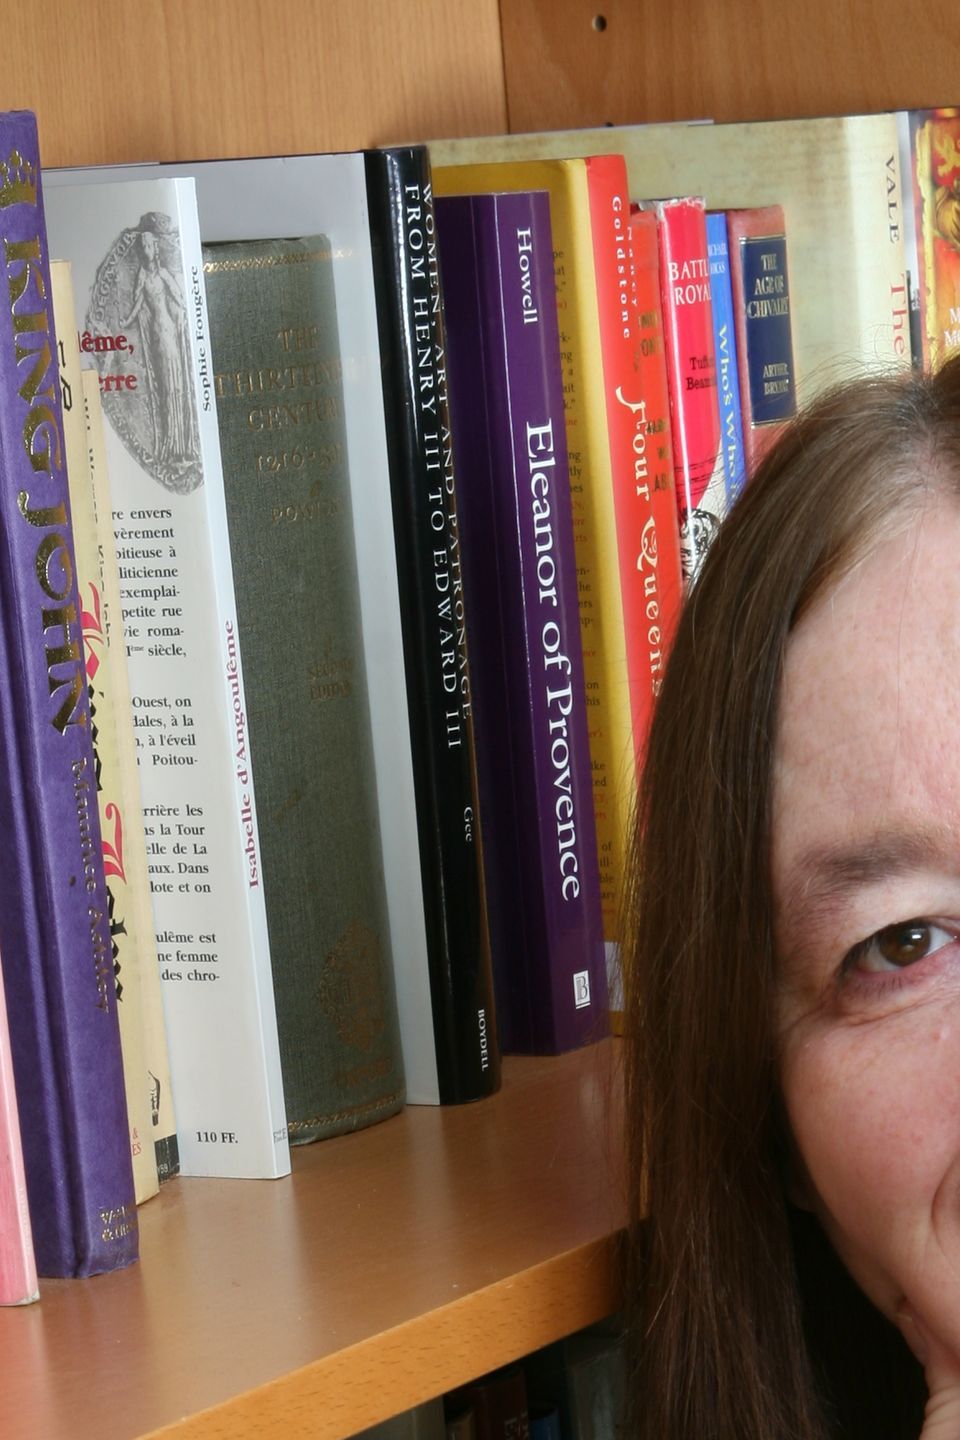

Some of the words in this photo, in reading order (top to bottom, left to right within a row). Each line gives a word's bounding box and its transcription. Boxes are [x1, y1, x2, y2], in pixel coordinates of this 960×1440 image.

[885, 155, 900, 244] VALE
[404, 184, 426, 280] FROM
[517, 227, 538, 324] Howell
[612, 196, 631, 339] Goldstone
[760, 253, 777, 271] THE
[191, 265, 204, 341] Fougère
[673, 284, 712, 306] ROYA
[754, 276, 774, 296] AGE
[775, 275, 785, 293] OF
[890, 273, 907, 355] The
[4, 235, 62, 479] KING
[413, 298, 438, 414] HENRY
[718, 324, 734, 406] Who's
[198, 347, 211, 412] Sophie
[435, 344, 448, 406] ART
[424, 431, 440, 471] III
[441, 425, 455, 494] AND
[615, 386, 649, 502] Four
[130, 508, 173, 520] envers
[428, 487, 445, 531] TO
[525, 417, 558, 608] Eleanor
[113, 527, 175, 540] vèrement
[169, 545, 177, 558] à
[119, 566, 178, 579] liticienne
[120, 585, 181, 601] exemplai-
[17, 489, 87, 737] JOHN
[122, 605, 156, 621] petite
[162, 607, 183, 617] rue
[147, 626, 185, 637] roma-
[433, 549, 457, 694] EDWARD
[448, 513, 471, 720] PATRONAGE
[148, 643, 187, 658] siècle,
[541, 621, 572, 676] of
[132, 696, 172, 710] Ouest,
[175, 697, 192, 708] on
[171, 714, 178, 727] à
[182, 714, 194, 727] la
[225, 619, 248, 786] d'Angoulême
[148, 734, 156, 747] à
[160, 733, 196, 747] l'éveil
[446, 710, 461, 749] III
[152, 754, 198, 766] Poitou-
[143, 804, 180, 817] rrière
[186, 803, 203, 817] les
[546, 681, 581, 902] Provence
[160, 824, 171, 836] la
[175, 823, 205, 836] Tour
[241, 793, 259, 889] Isabelle
[464, 806, 473, 842] Gee
[172, 842, 187, 855] de
[193, 843, 207, 855] La
[148, 864, 174, 874] aux.
[178, 861, 209, 874] Dans
[150, 880, 174, 893] lote
[178, 882, 190, 893] et
[194, 883, 211, 893] on
[156, 930, 193, 943] ulême
[199, 932, 216, 943] est
[157, 952, 172, 963] ne
[176, 950, 219, 963] femme
[161, 968, 182, 981] des
[187, 968, 220, 981] chro-
[478, 1008, 488, 1071] BOYDELL
[196, 1130, 217, 1143] 110
[221, 1131, 239, 1144] FF.
